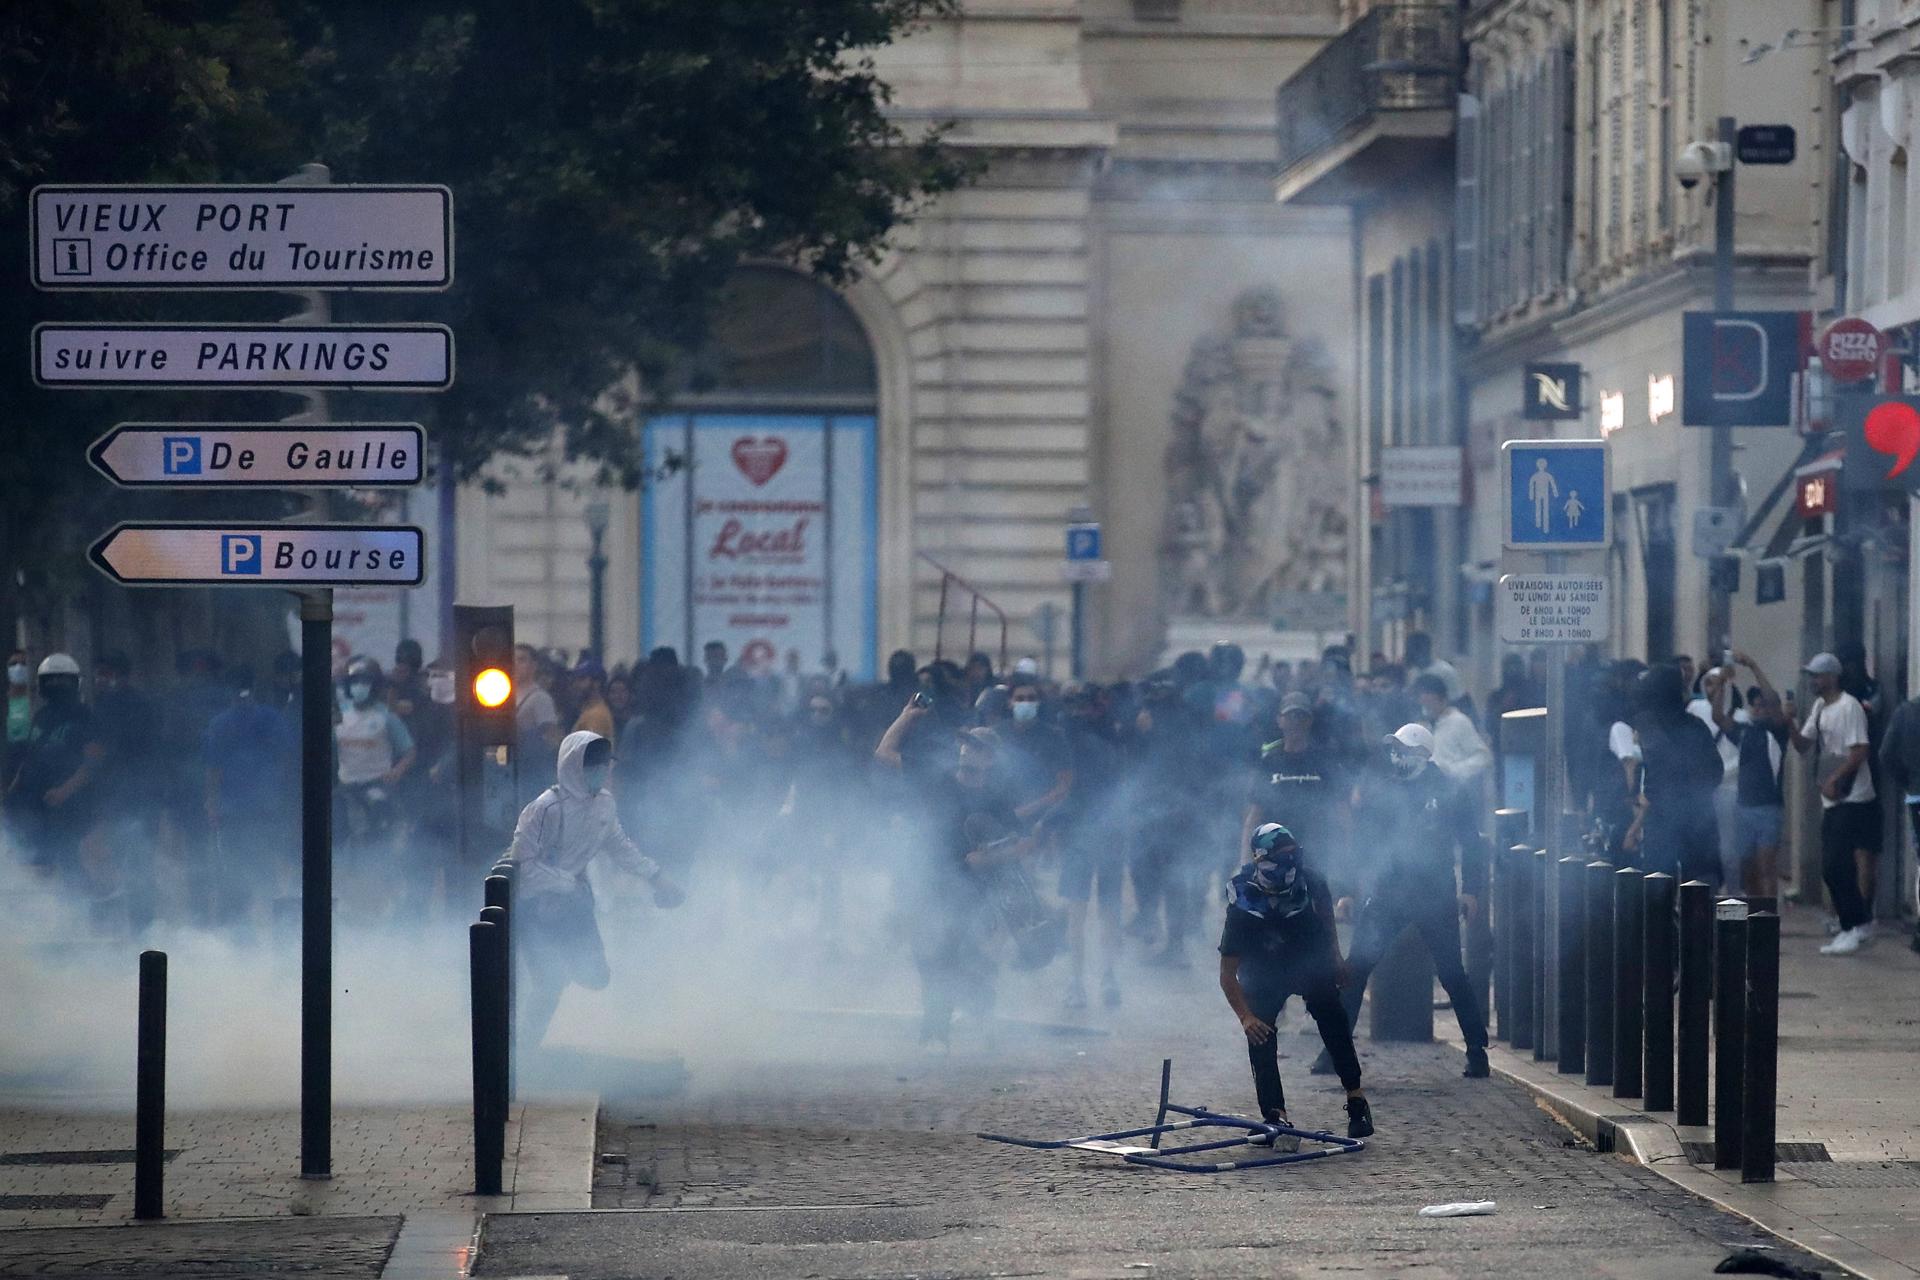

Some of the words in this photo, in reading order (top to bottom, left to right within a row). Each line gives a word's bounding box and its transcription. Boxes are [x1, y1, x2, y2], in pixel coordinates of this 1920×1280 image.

[55, 204, 167, 232] VIEUX
[196, 204, 296, 232] PORT
[106, 243, 208, 271] Office
[229, 243, 265, 271] du
[288, 243, 434, 271] Tourisme
[1830, 332, 1877, 349] PIZZA
[55, 342, 168, 370] suivre
[197, 342, 390, 371] PARKINGS
[171, 443, 194, 472] P
[210, 443, 255, 470] De
[287, 442, 408, 470] Gaulle
[709, 515, 809, 560] Local
[228, 538, 254, 571] P
[275, 542, 405, 569] Bourse
[1508, 581, 1553, 590] LIVRAISONS
[1528, 593, 1551, 602] LUNDI
[1556, 593, 1566, 602] AU
[1570, 593, 1599, 602] SAMEDI
[1521, 606, 1530, 615] DE
[1558, 606, 1562, 615] A
[1568, 606, 1591, 615] 10H00
[1529, 617, 1537, 626] LE
[1541, 617, 1581, 626] DIMANCHE
[1521, 629, 1530, 638] DE
[1558, 629, 1563, 638] A
